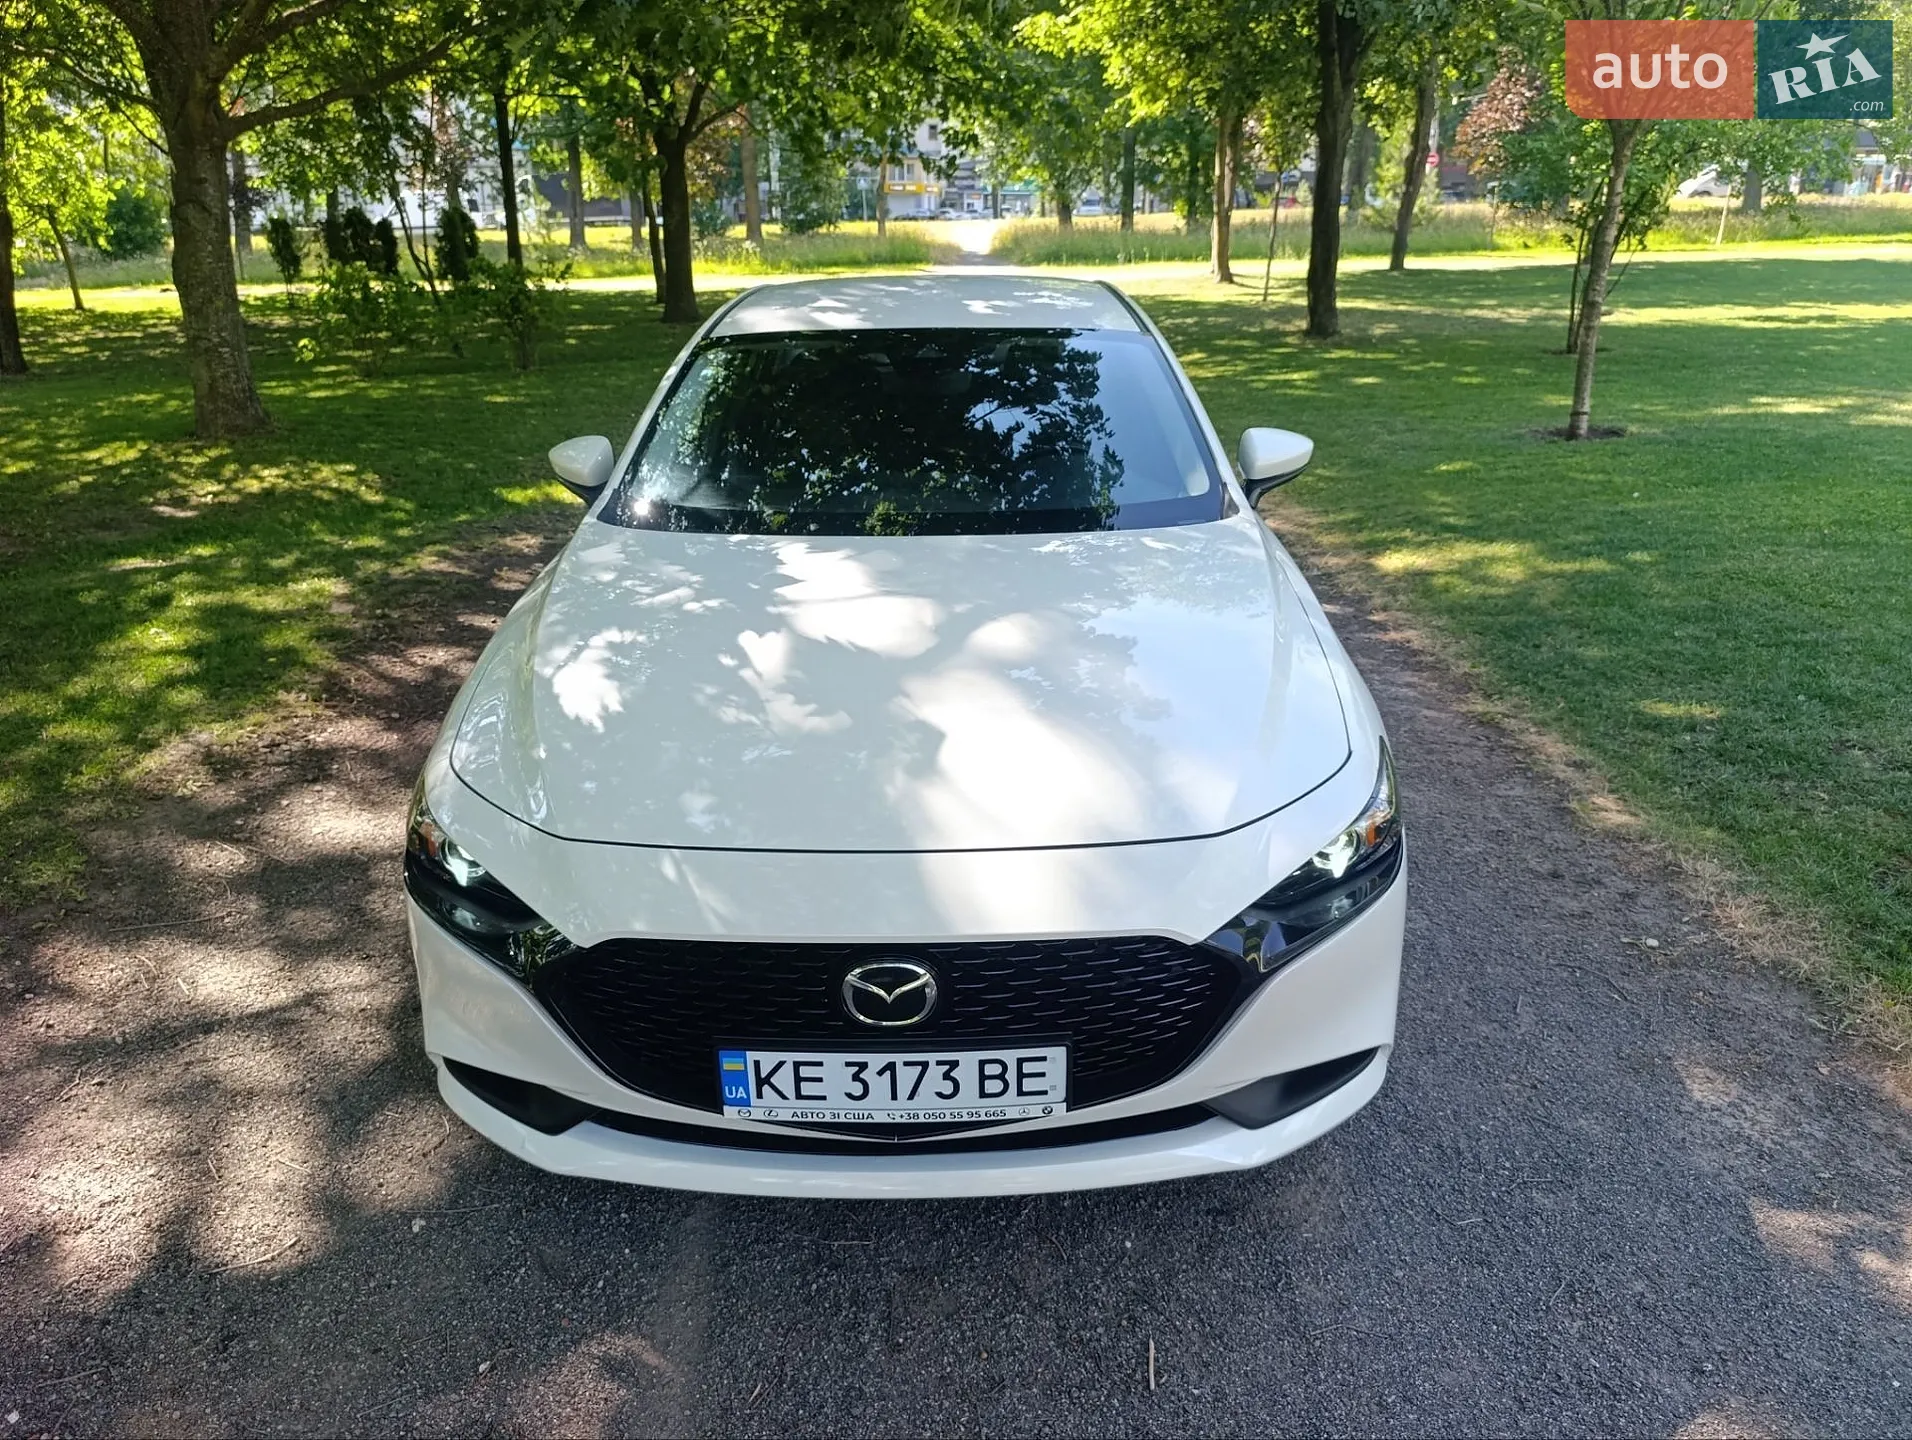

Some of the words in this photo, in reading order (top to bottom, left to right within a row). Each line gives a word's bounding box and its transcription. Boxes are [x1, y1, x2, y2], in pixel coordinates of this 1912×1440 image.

[753, 1059, 828, 1101] KE
[844, 1059, 961, 1102] 3173
[977, 1055, 1049, 1100] BE
[725, 1085, 747, 1100] UA
[791, 1110, 826, 1120] АВТО
[843, 1111, 875, 1121] США
[923, 1111, 946, 1120] 050
[949, 1110, 964, 1120] 55
[966, 1110, 982, 1120] 95
[984, 1108, 1007, 1119] 665
